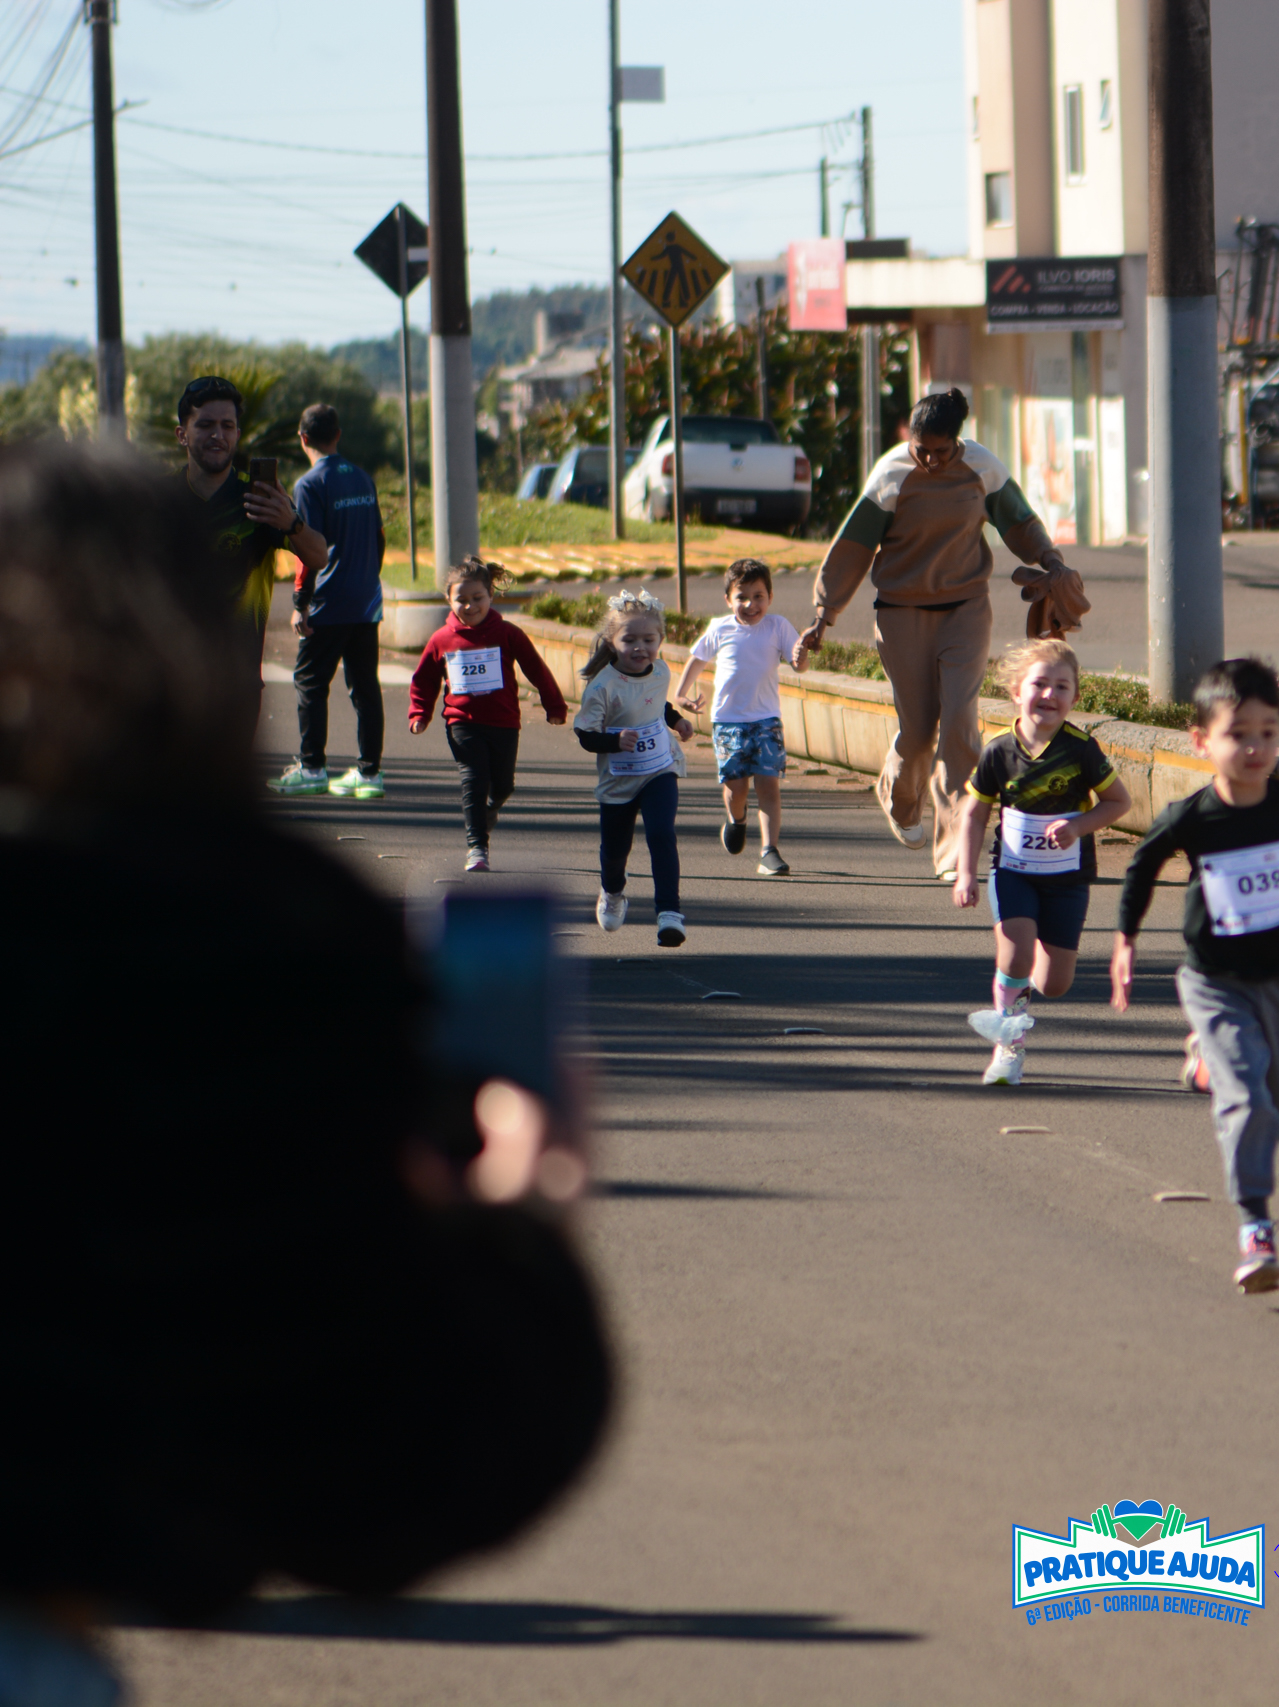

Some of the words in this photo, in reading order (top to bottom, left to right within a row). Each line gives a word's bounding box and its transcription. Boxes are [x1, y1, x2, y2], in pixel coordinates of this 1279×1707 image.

[1037, 269, 1071, 284] ILVO
[1074, 267, 1116, 283] IORIS
[991, 304, 1029, 317] COMPRA
[1037, 303, 1065, 316] VENDA
[1073, 300, 1119, 315] LOCAÇÃO
[461, 664, 486, 676] 228
[631, 738, 656, 753] 83
